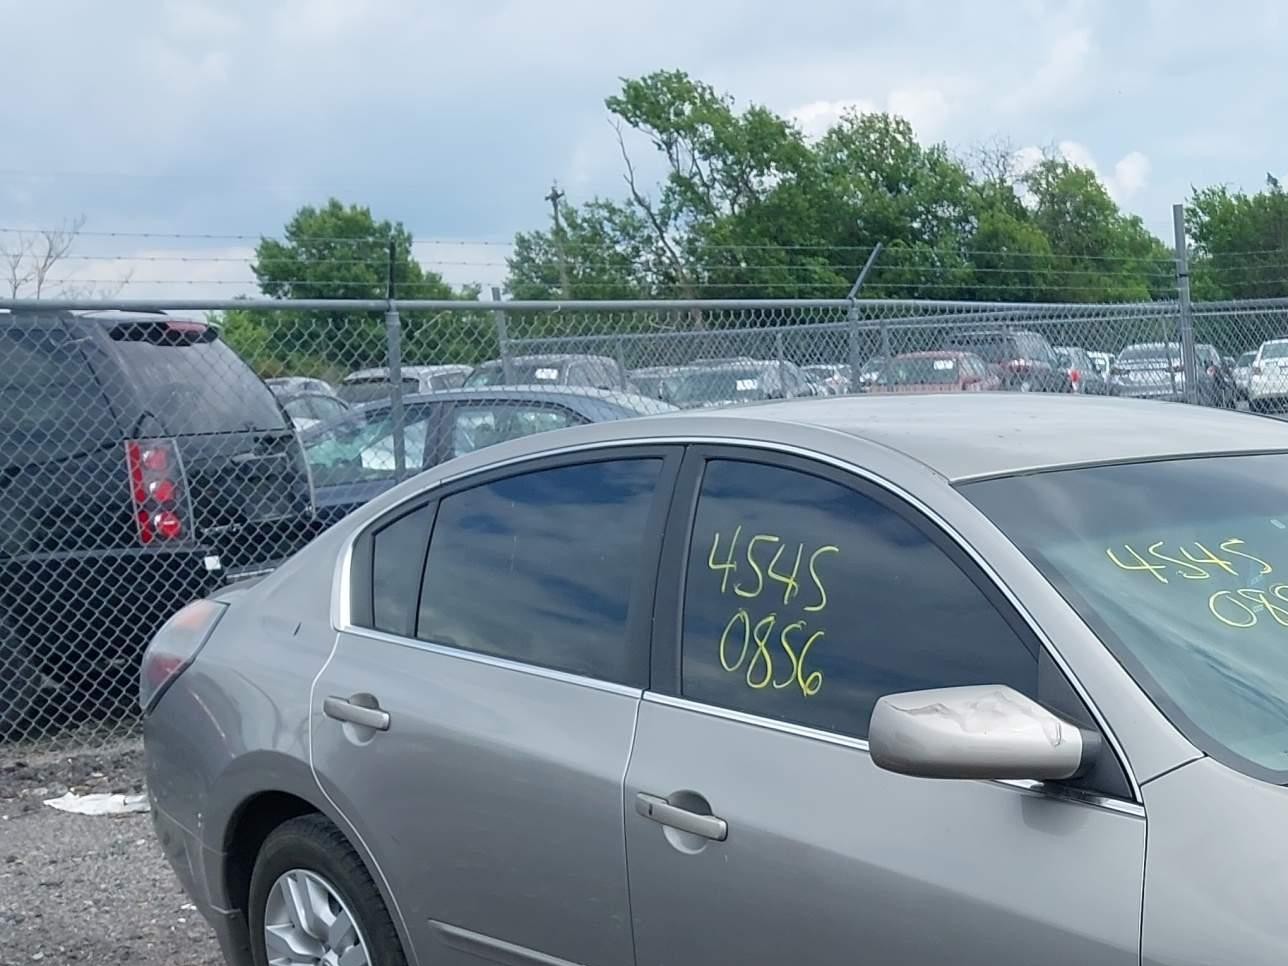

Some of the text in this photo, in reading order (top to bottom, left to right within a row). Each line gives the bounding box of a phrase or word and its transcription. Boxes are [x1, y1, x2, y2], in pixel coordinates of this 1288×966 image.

[708, 525, 839, 611] 4545
[1106, 538, 1272, 583] 4545
[720, 608, 825, 696] 0856
